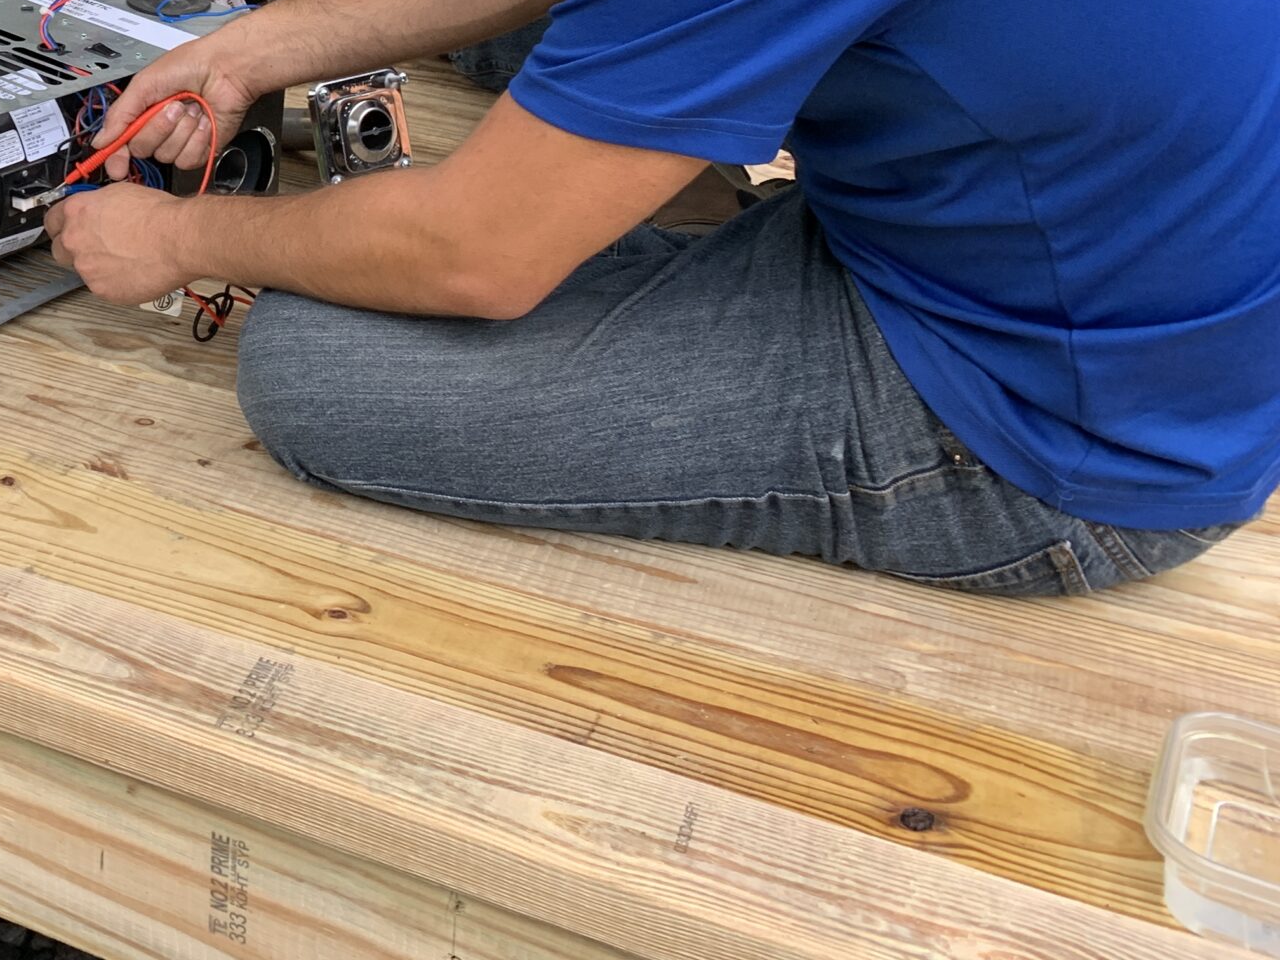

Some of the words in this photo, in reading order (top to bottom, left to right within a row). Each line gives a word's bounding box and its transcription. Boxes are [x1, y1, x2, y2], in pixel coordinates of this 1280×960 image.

[210, 831, 230, 878] PRIME
[237, 840, 250, 869] SYP
[228, 911, 247, 945] 333
